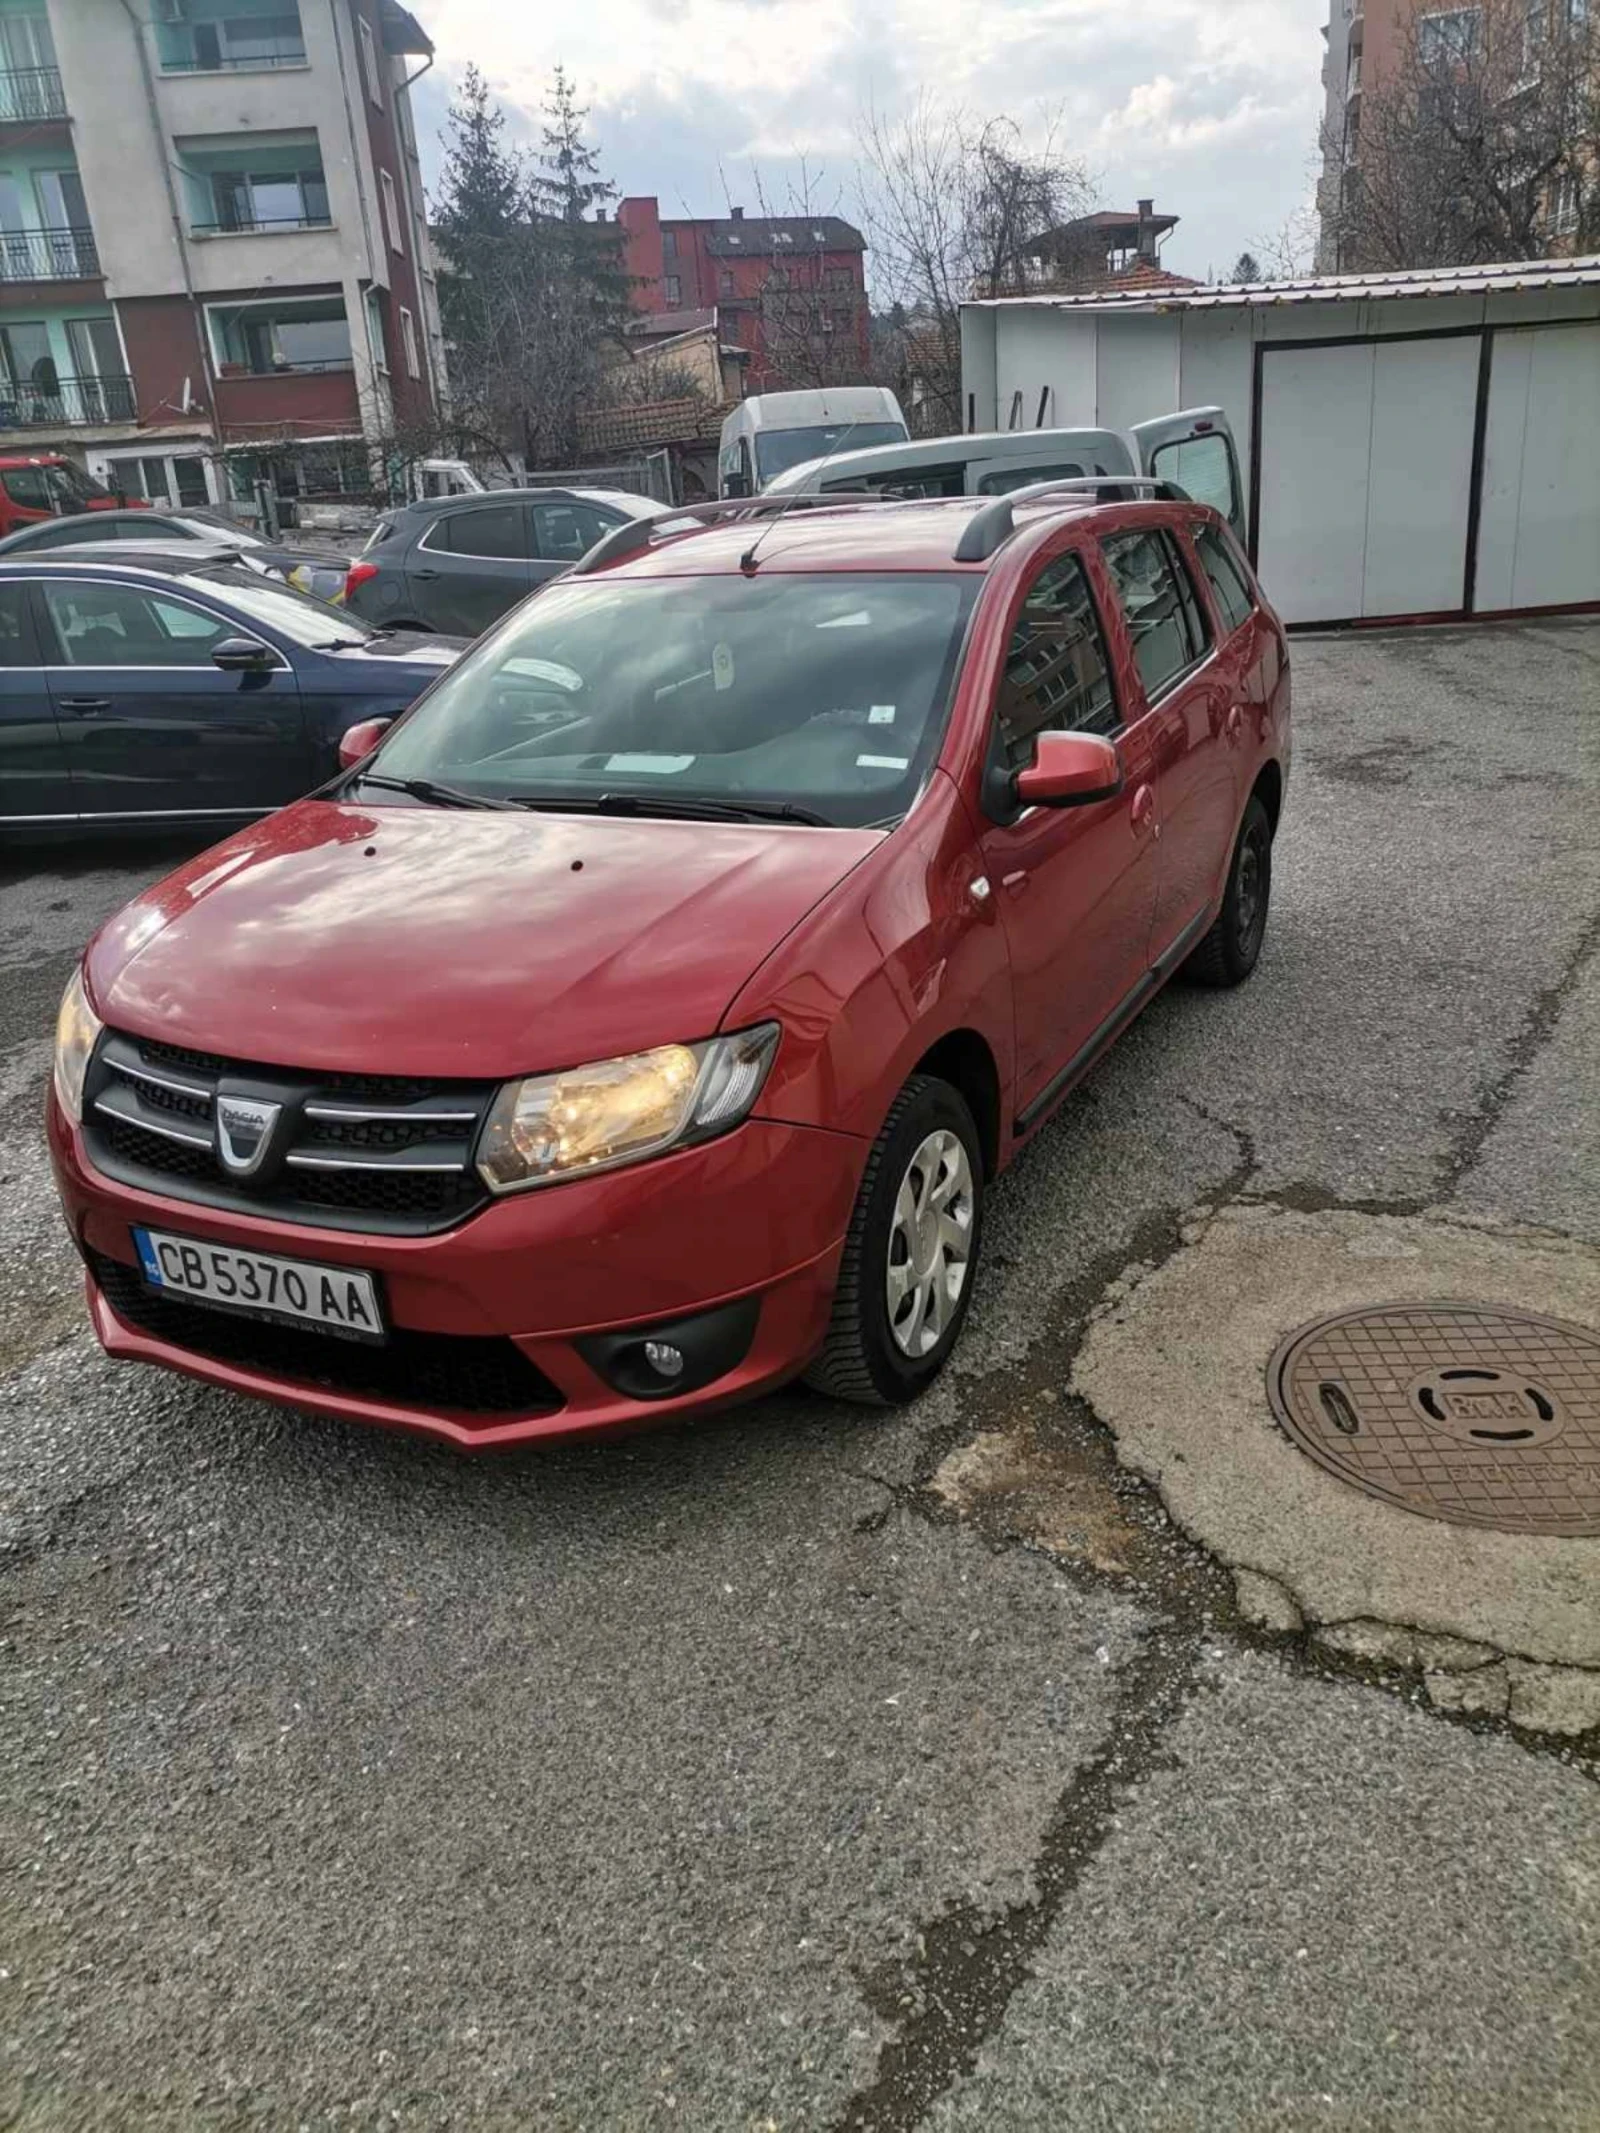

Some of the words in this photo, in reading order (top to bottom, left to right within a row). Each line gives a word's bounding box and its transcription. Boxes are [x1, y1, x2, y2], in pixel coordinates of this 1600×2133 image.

[223, 1108, 264, 1124] DACIA
[157, 1241, 207, 1290] CB
[211, 1253, 307, 1311] 5370
[320, 1275, 372, 1326] AA
